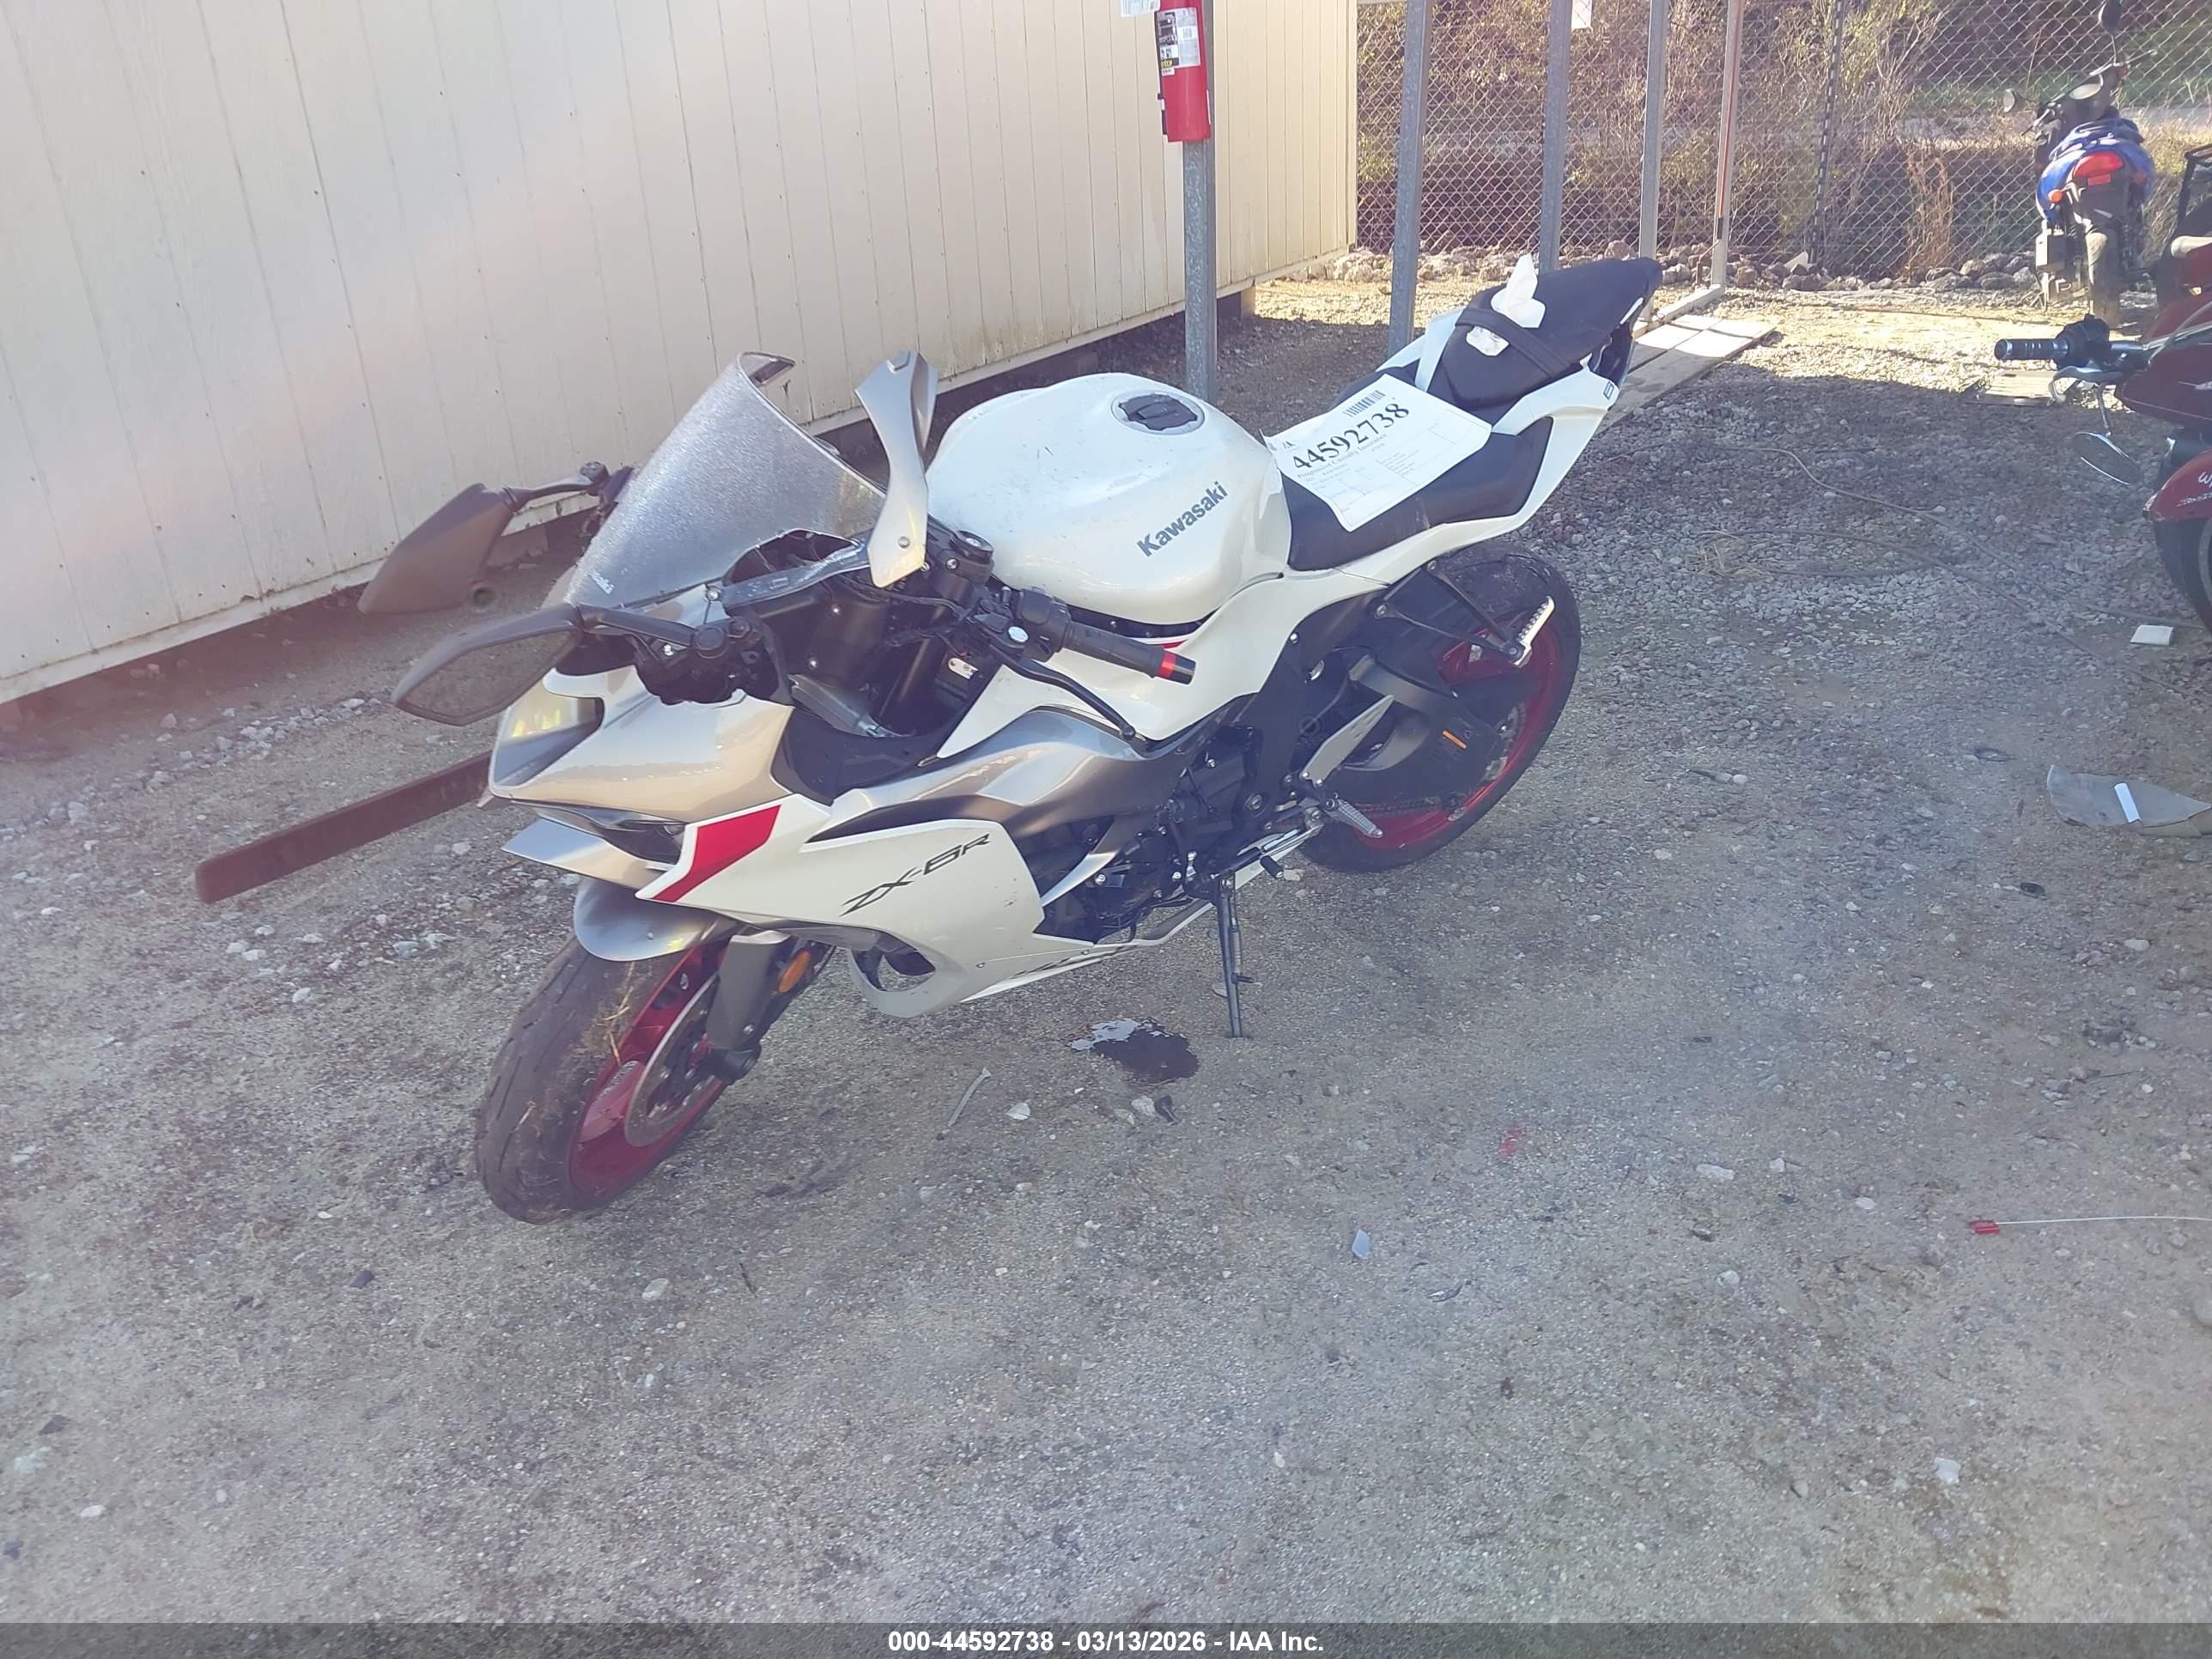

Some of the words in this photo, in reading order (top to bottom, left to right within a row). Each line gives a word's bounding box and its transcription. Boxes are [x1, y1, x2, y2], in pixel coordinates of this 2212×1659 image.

[1292, 403, 1409, 469] 44592738
[1137, 481, 1229, 556] Kawasaki
[839, 833, 992, 917] ZX-6R
